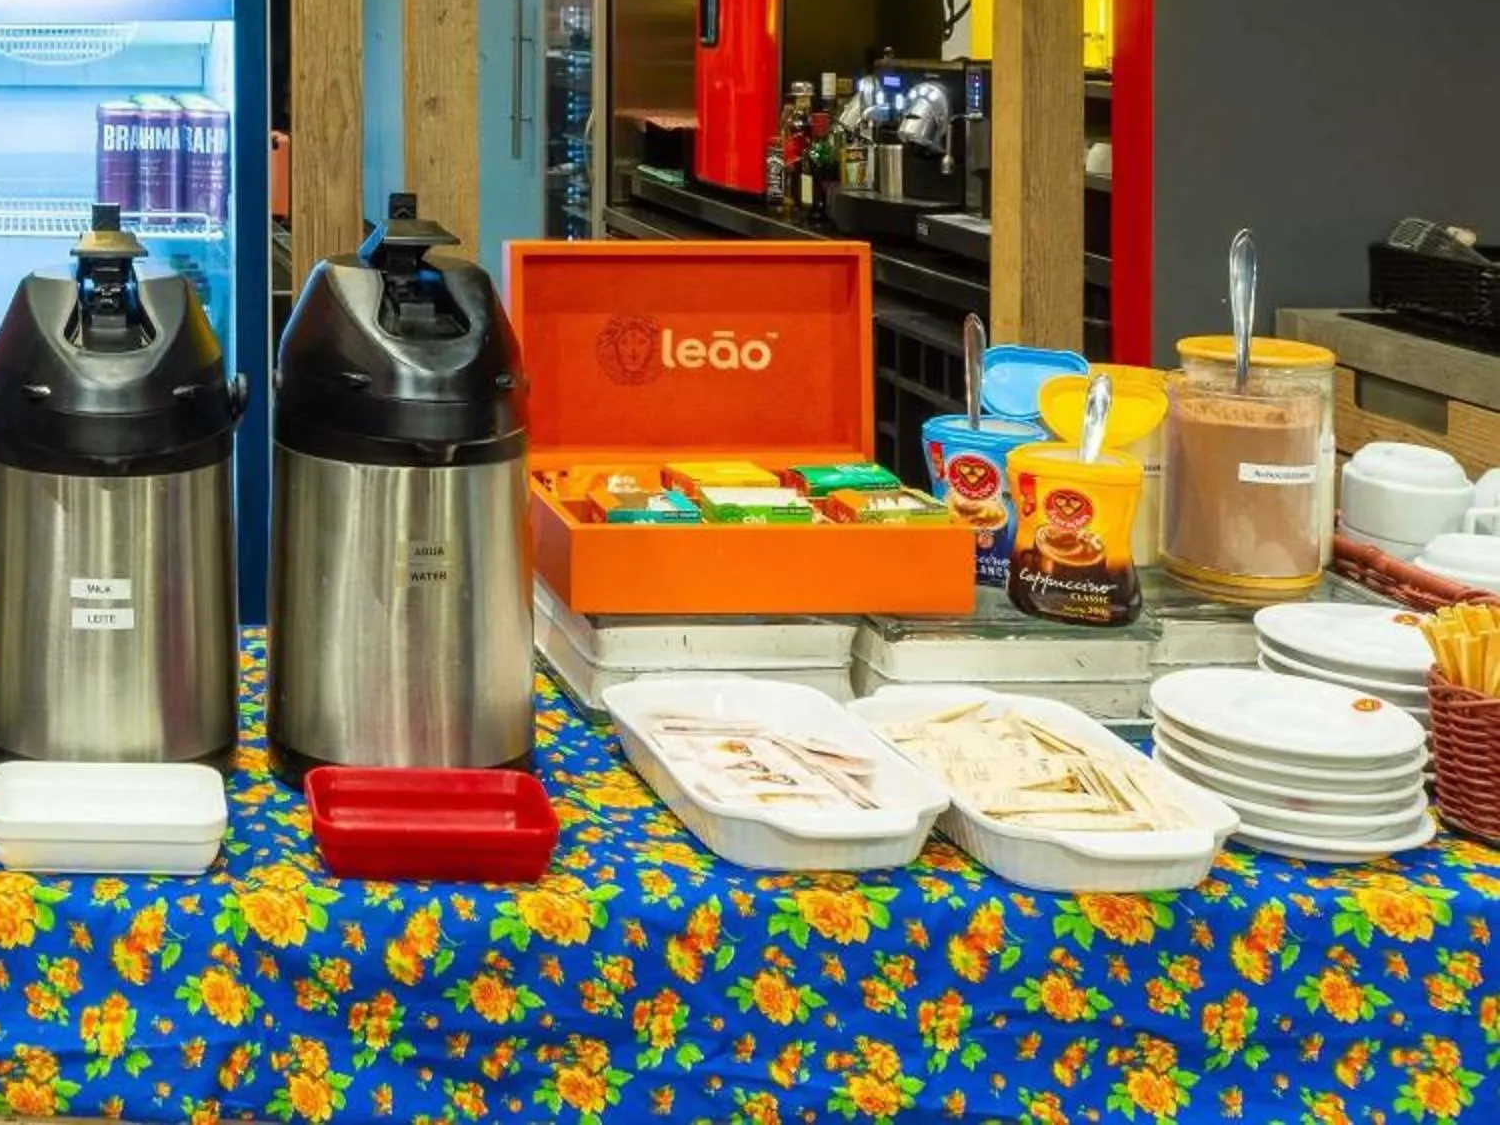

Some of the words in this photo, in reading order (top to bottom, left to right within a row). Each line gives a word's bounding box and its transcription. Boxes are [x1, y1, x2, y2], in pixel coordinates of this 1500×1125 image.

[662, 328, 771, 370] leão
[411, 570, 447, 581] WATER
[1019, 568, 1117, 596] Cappuccino
[87, 614, 116, 624] LEITE
